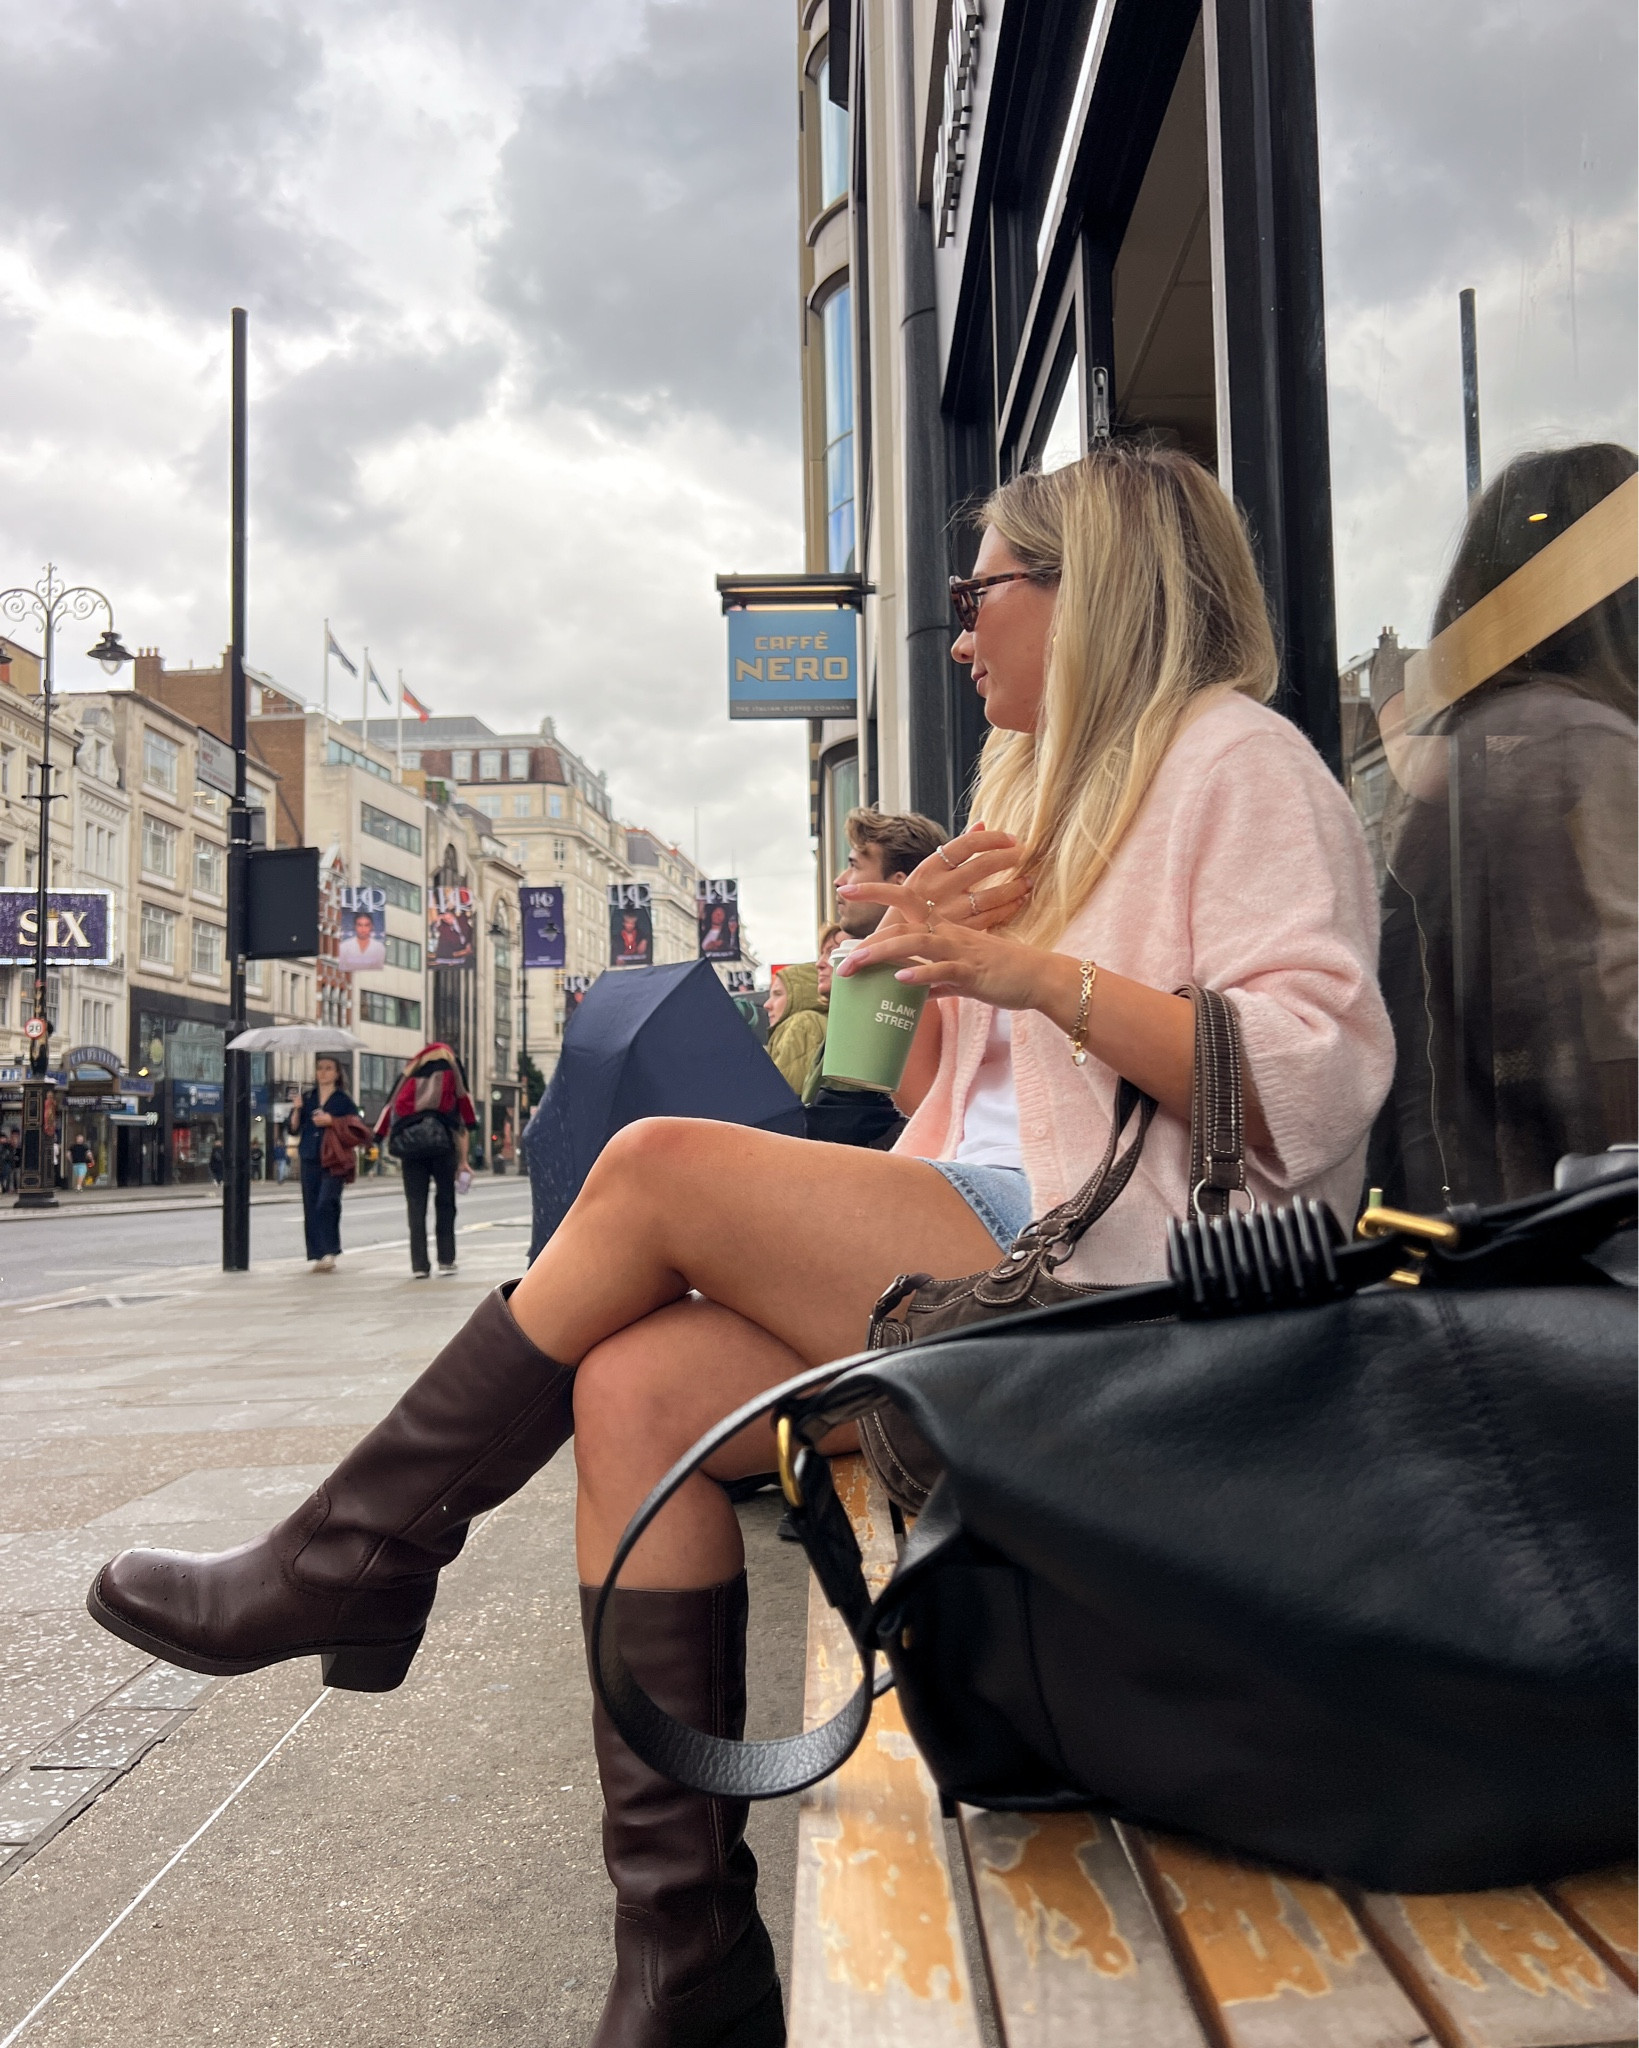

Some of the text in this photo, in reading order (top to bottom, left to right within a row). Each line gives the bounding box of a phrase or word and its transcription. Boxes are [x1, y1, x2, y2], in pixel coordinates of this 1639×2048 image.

[754, 631, 829, 651] CAFFÈ
[735, 656, 849, 682] NERO
[881, 999, 917, 1019] BLANK
[29, 1024, 41, 1034] 20
[875, 1012, 915, 1032] STREET
